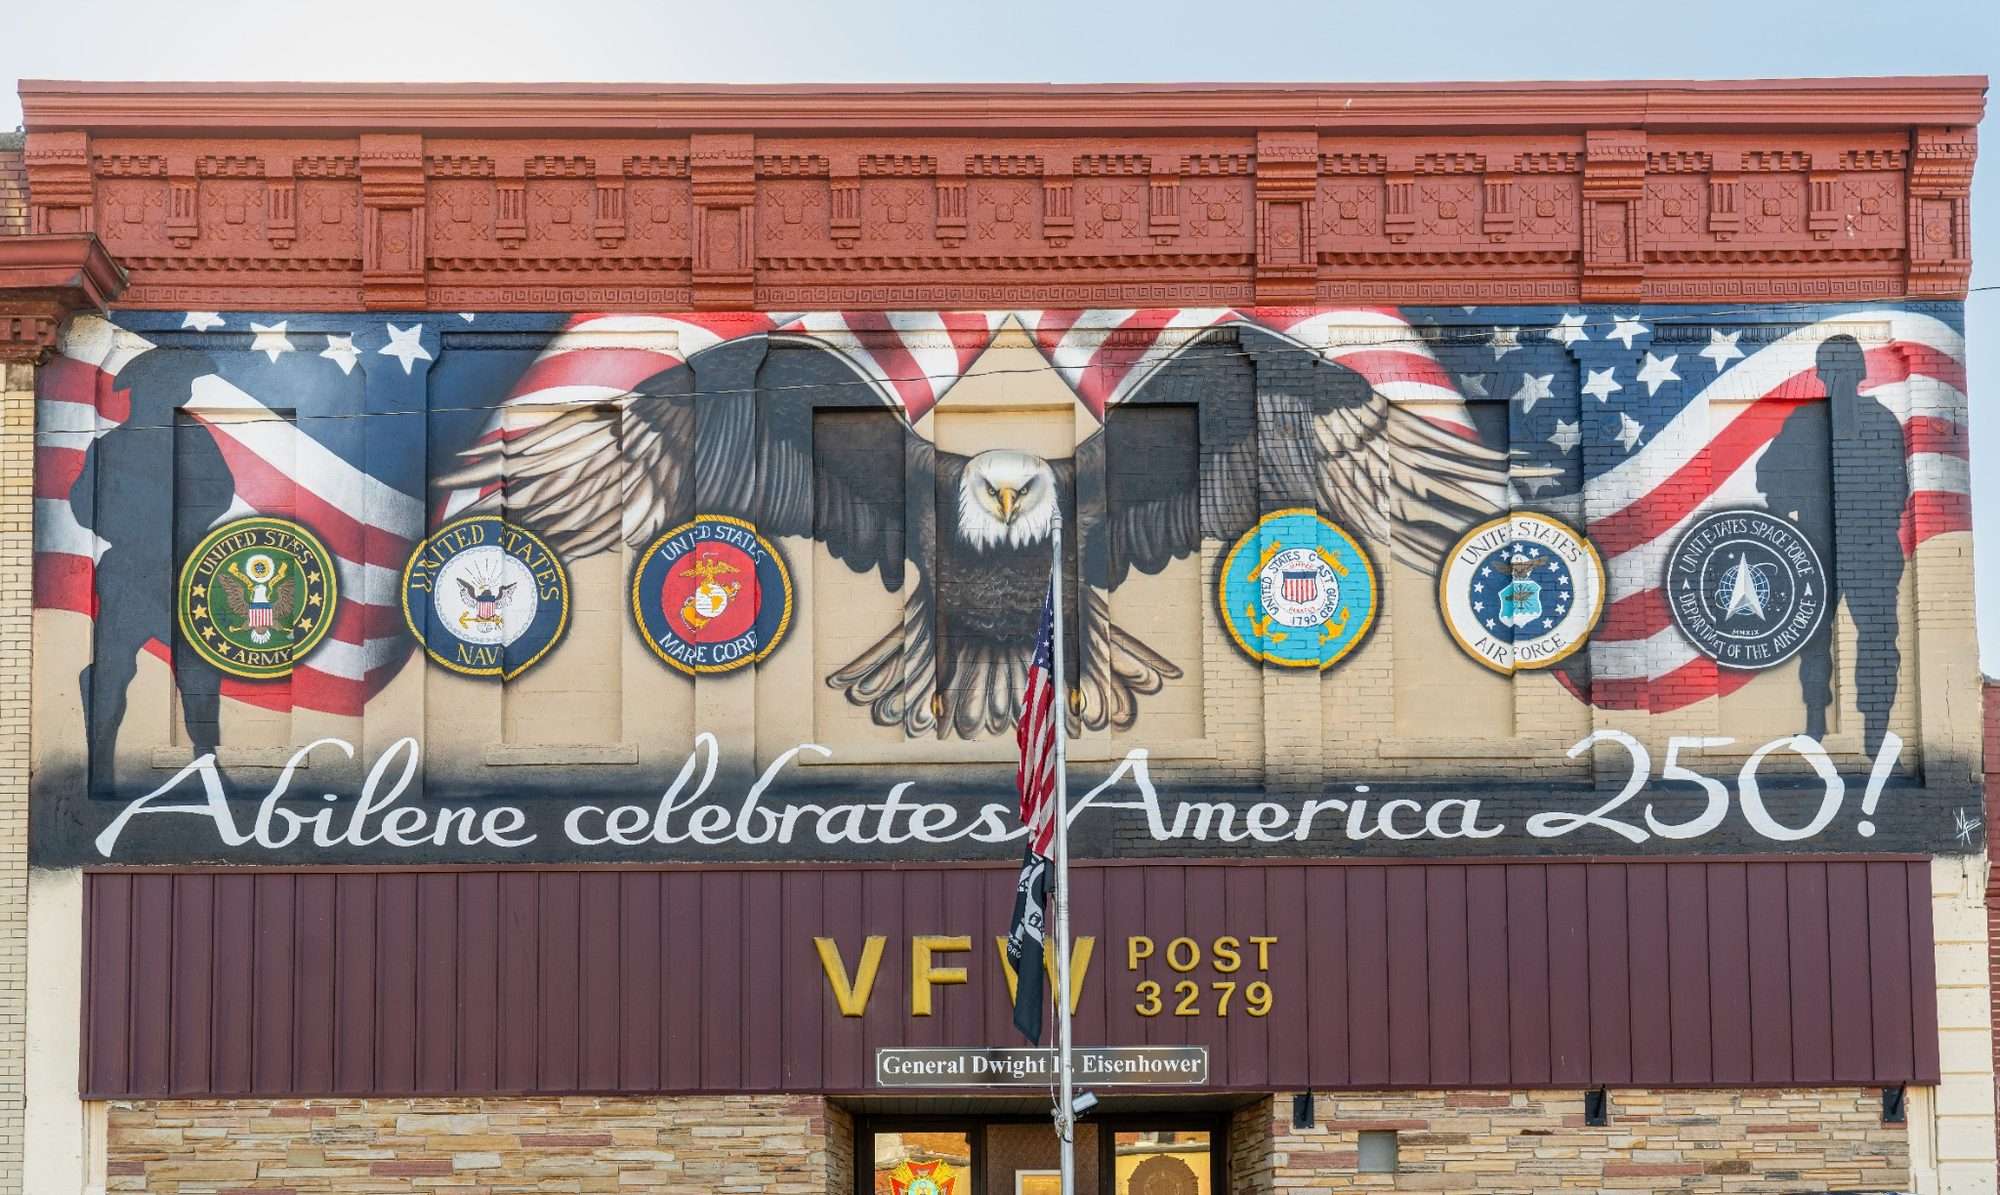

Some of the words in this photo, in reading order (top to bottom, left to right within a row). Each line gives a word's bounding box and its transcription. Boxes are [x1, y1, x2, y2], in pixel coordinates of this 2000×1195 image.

[199, 531, 257, 576] UNITED
[1519, 521, 1582, 562] STATES
[1750, 520, 1792, 549] SPACE
[1784, 540, 1815, 578] FORCE
[1268, 550, 1301, 574] STATES
[1308, 552, 1335, 583] CAST
[1262, 576, 1280, 616] UNITED
[1320, 587, 1337, 618] GUARD
[1292, 614, 1318, 625] 1790
[233, 648, 291, 666] ARMY
[456, 643, 503, 666] NAV
[713, 631, 758, 663] CORP
[1475, 636, 1508, 665] AIR
[1727, 644, 1741, 659] OF
[1744, 643, 1772, 660] THE
[95, 736, 537, 858] Abilene
[564, 732, 1030, 846] celebrates
[1066, 748, 1505, 842] America
[1525, 730, 1903, 844] 250!
[1127, 935, 1278, 974] POST
[813, 935, 1096, 1018] VFW
[1135, 979, 1273, 1018] 3279
[882, 1055, 964, 1075] General
[971, 1054, 1046, 1078] Dwight
[1083, 1053, 1201, 1074] Eisenhower
